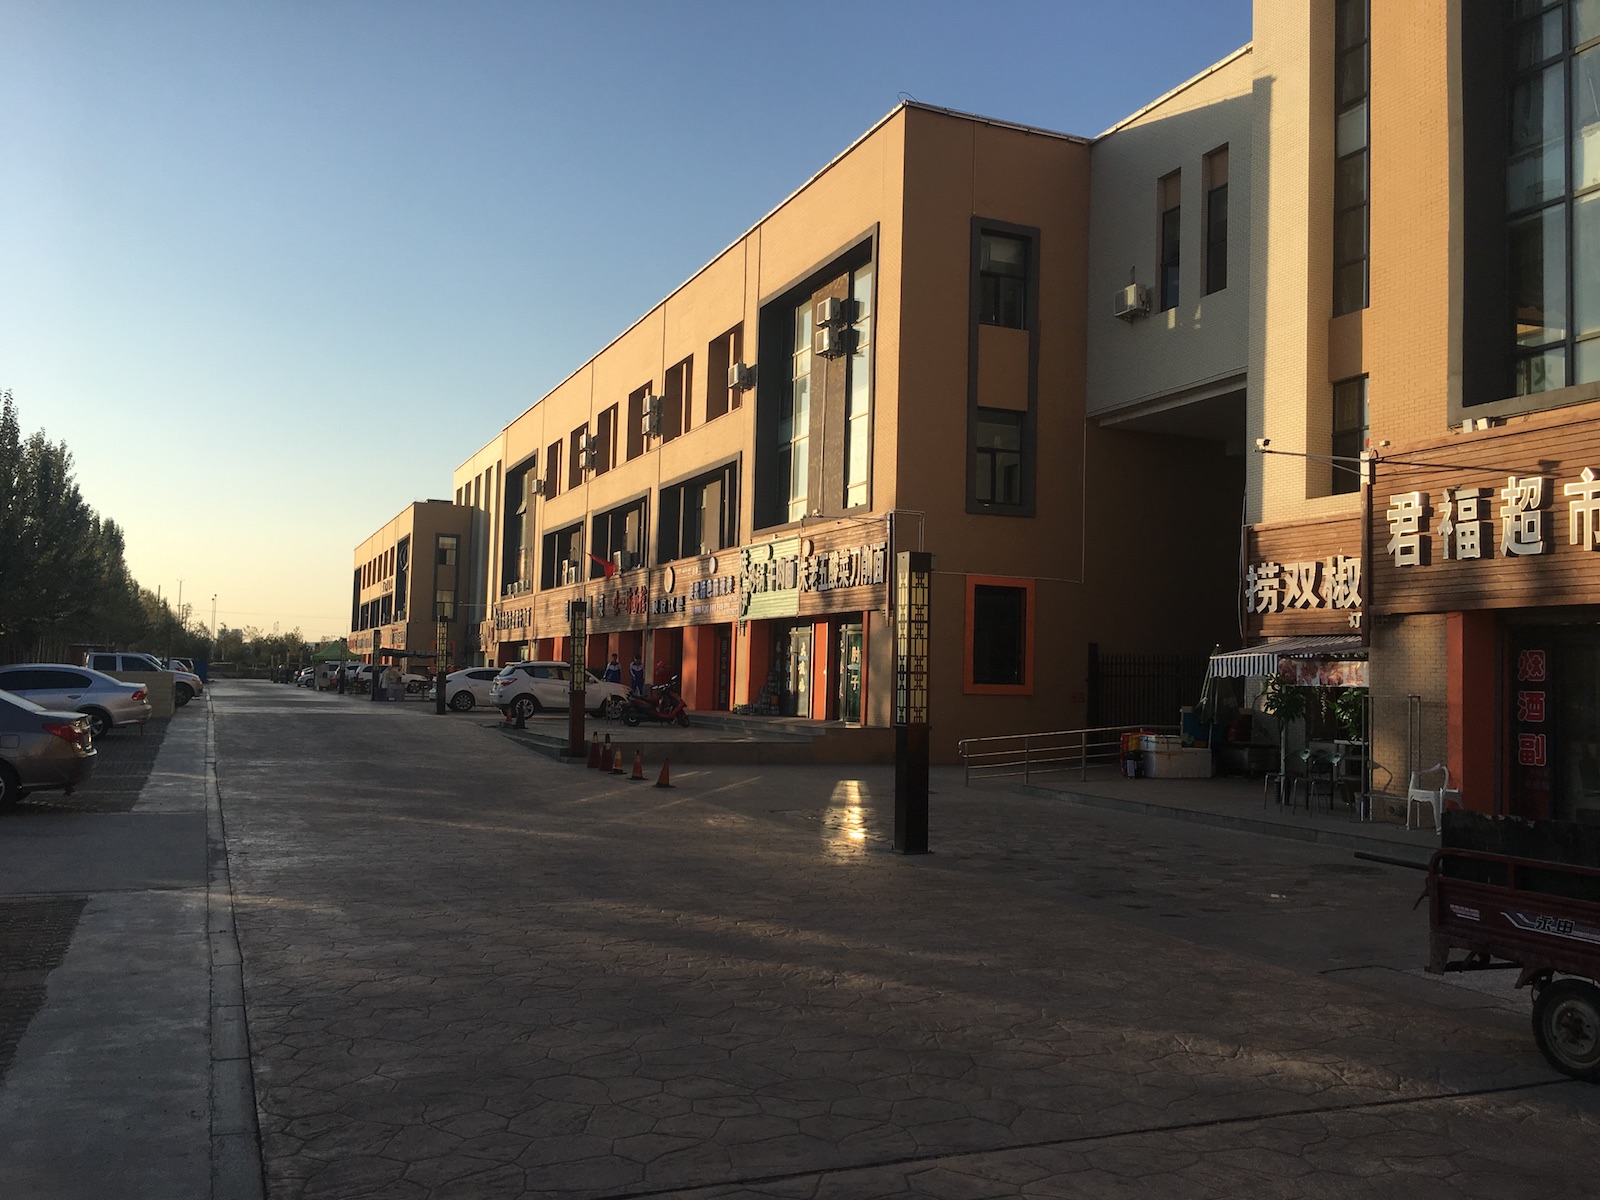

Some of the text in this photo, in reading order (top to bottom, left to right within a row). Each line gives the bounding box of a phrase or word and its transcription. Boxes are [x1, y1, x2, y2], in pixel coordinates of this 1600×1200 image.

[1387, 467, 1600, 568] 君福超市
[1245, 555, 1363, 614] 捞双椒
[1517, 649, 1547, 767] 烟酒副
